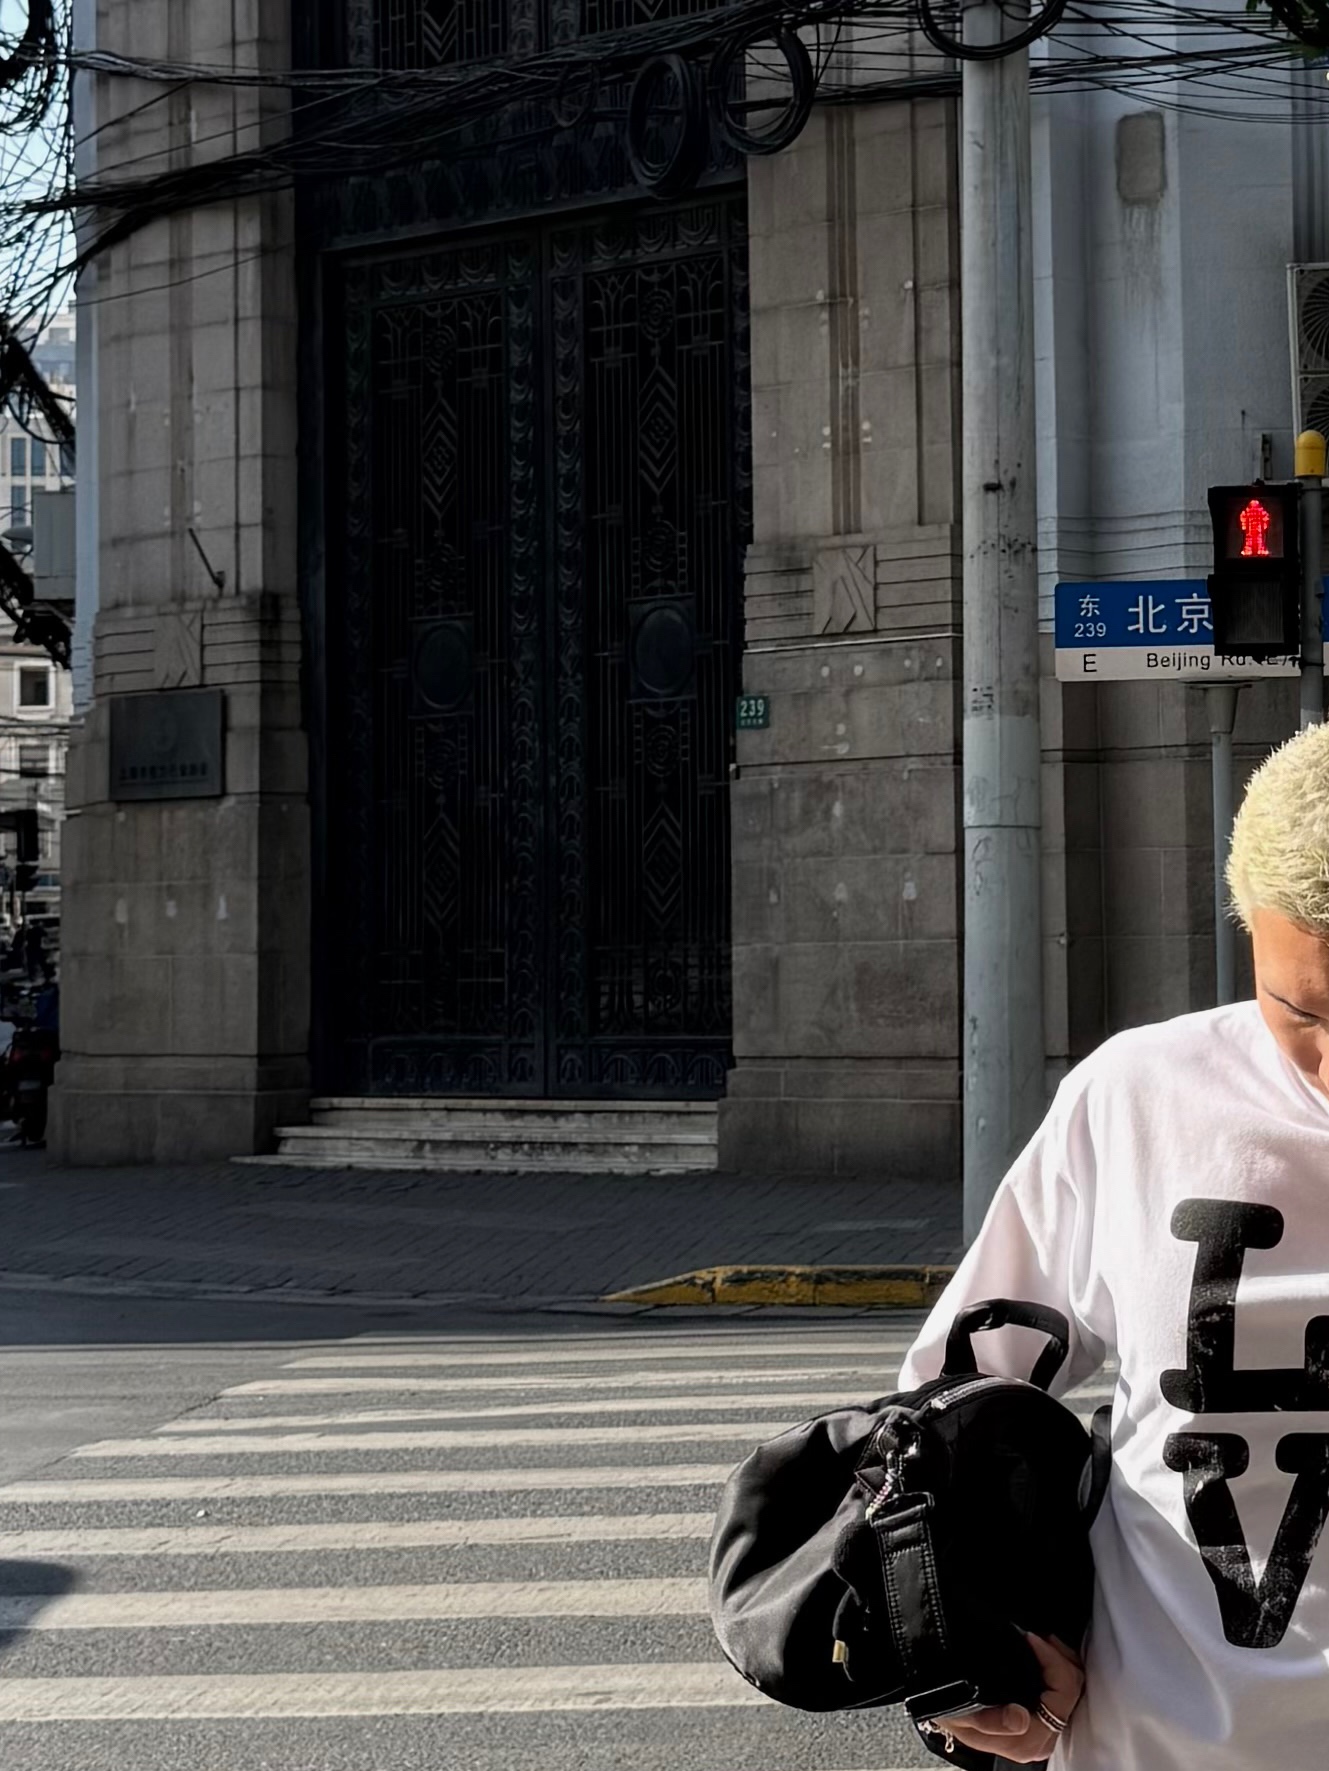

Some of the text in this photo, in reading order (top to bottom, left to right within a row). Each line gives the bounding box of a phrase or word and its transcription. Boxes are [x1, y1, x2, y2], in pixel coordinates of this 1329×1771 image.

[1078, 594, 1101, 618] 东
[1073, 622, 1107, 638] 239
[1082, 653, 1098, 673] E
[1146, 652, 1211, 671] Beijing
[740, 698, 765, 718] 239
